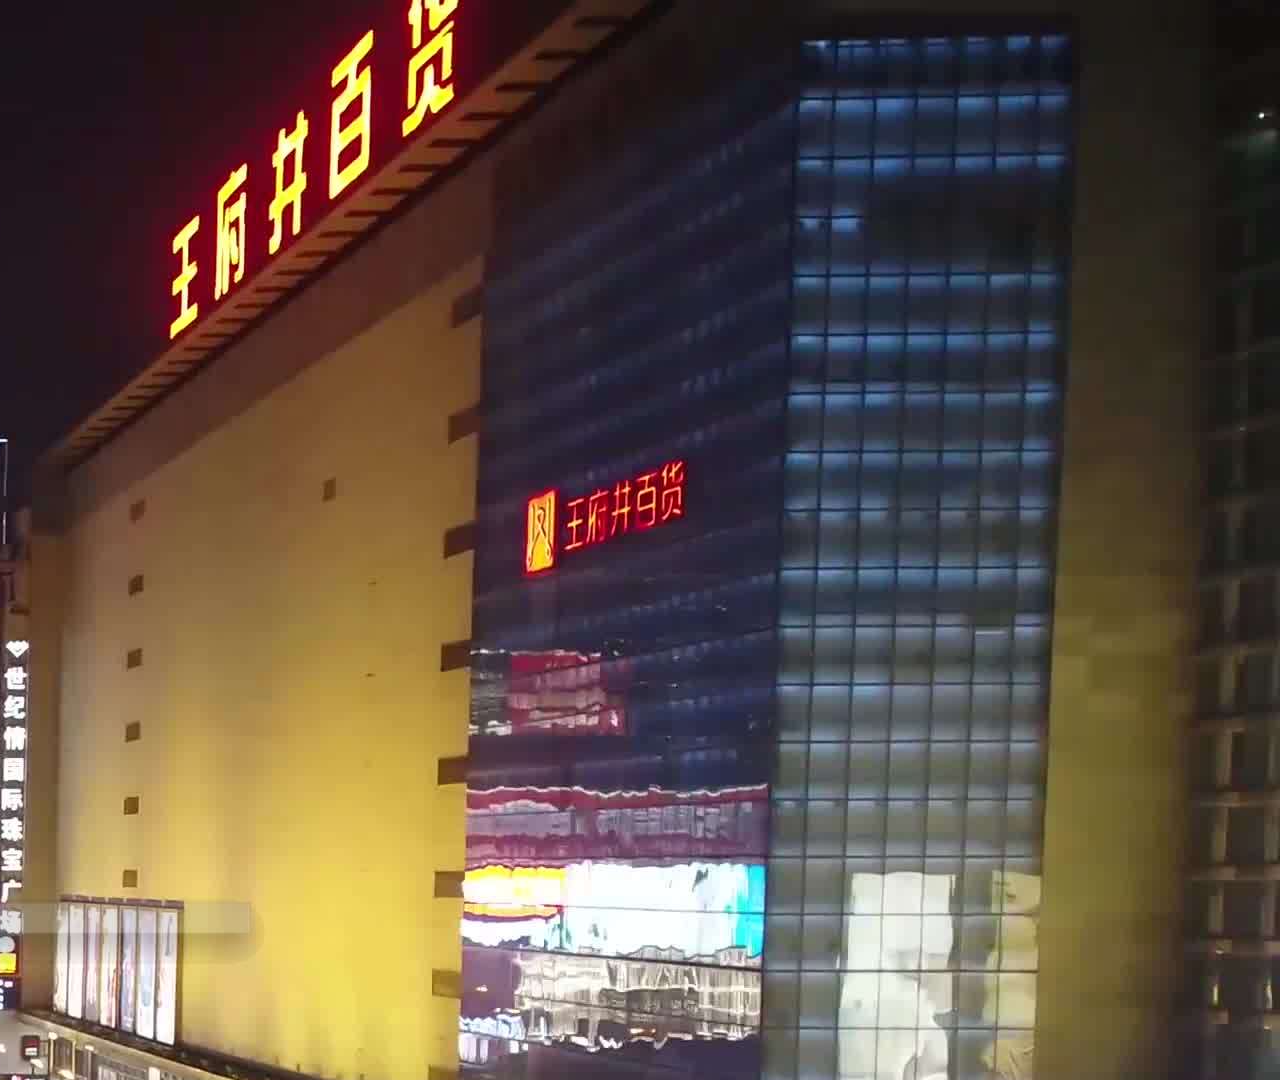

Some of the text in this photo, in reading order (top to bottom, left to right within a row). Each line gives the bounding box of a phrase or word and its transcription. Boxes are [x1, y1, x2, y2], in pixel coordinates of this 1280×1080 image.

[169, 0, 459, 340] 王府井百货
[563, 460, 685, 551] 王府井百货
